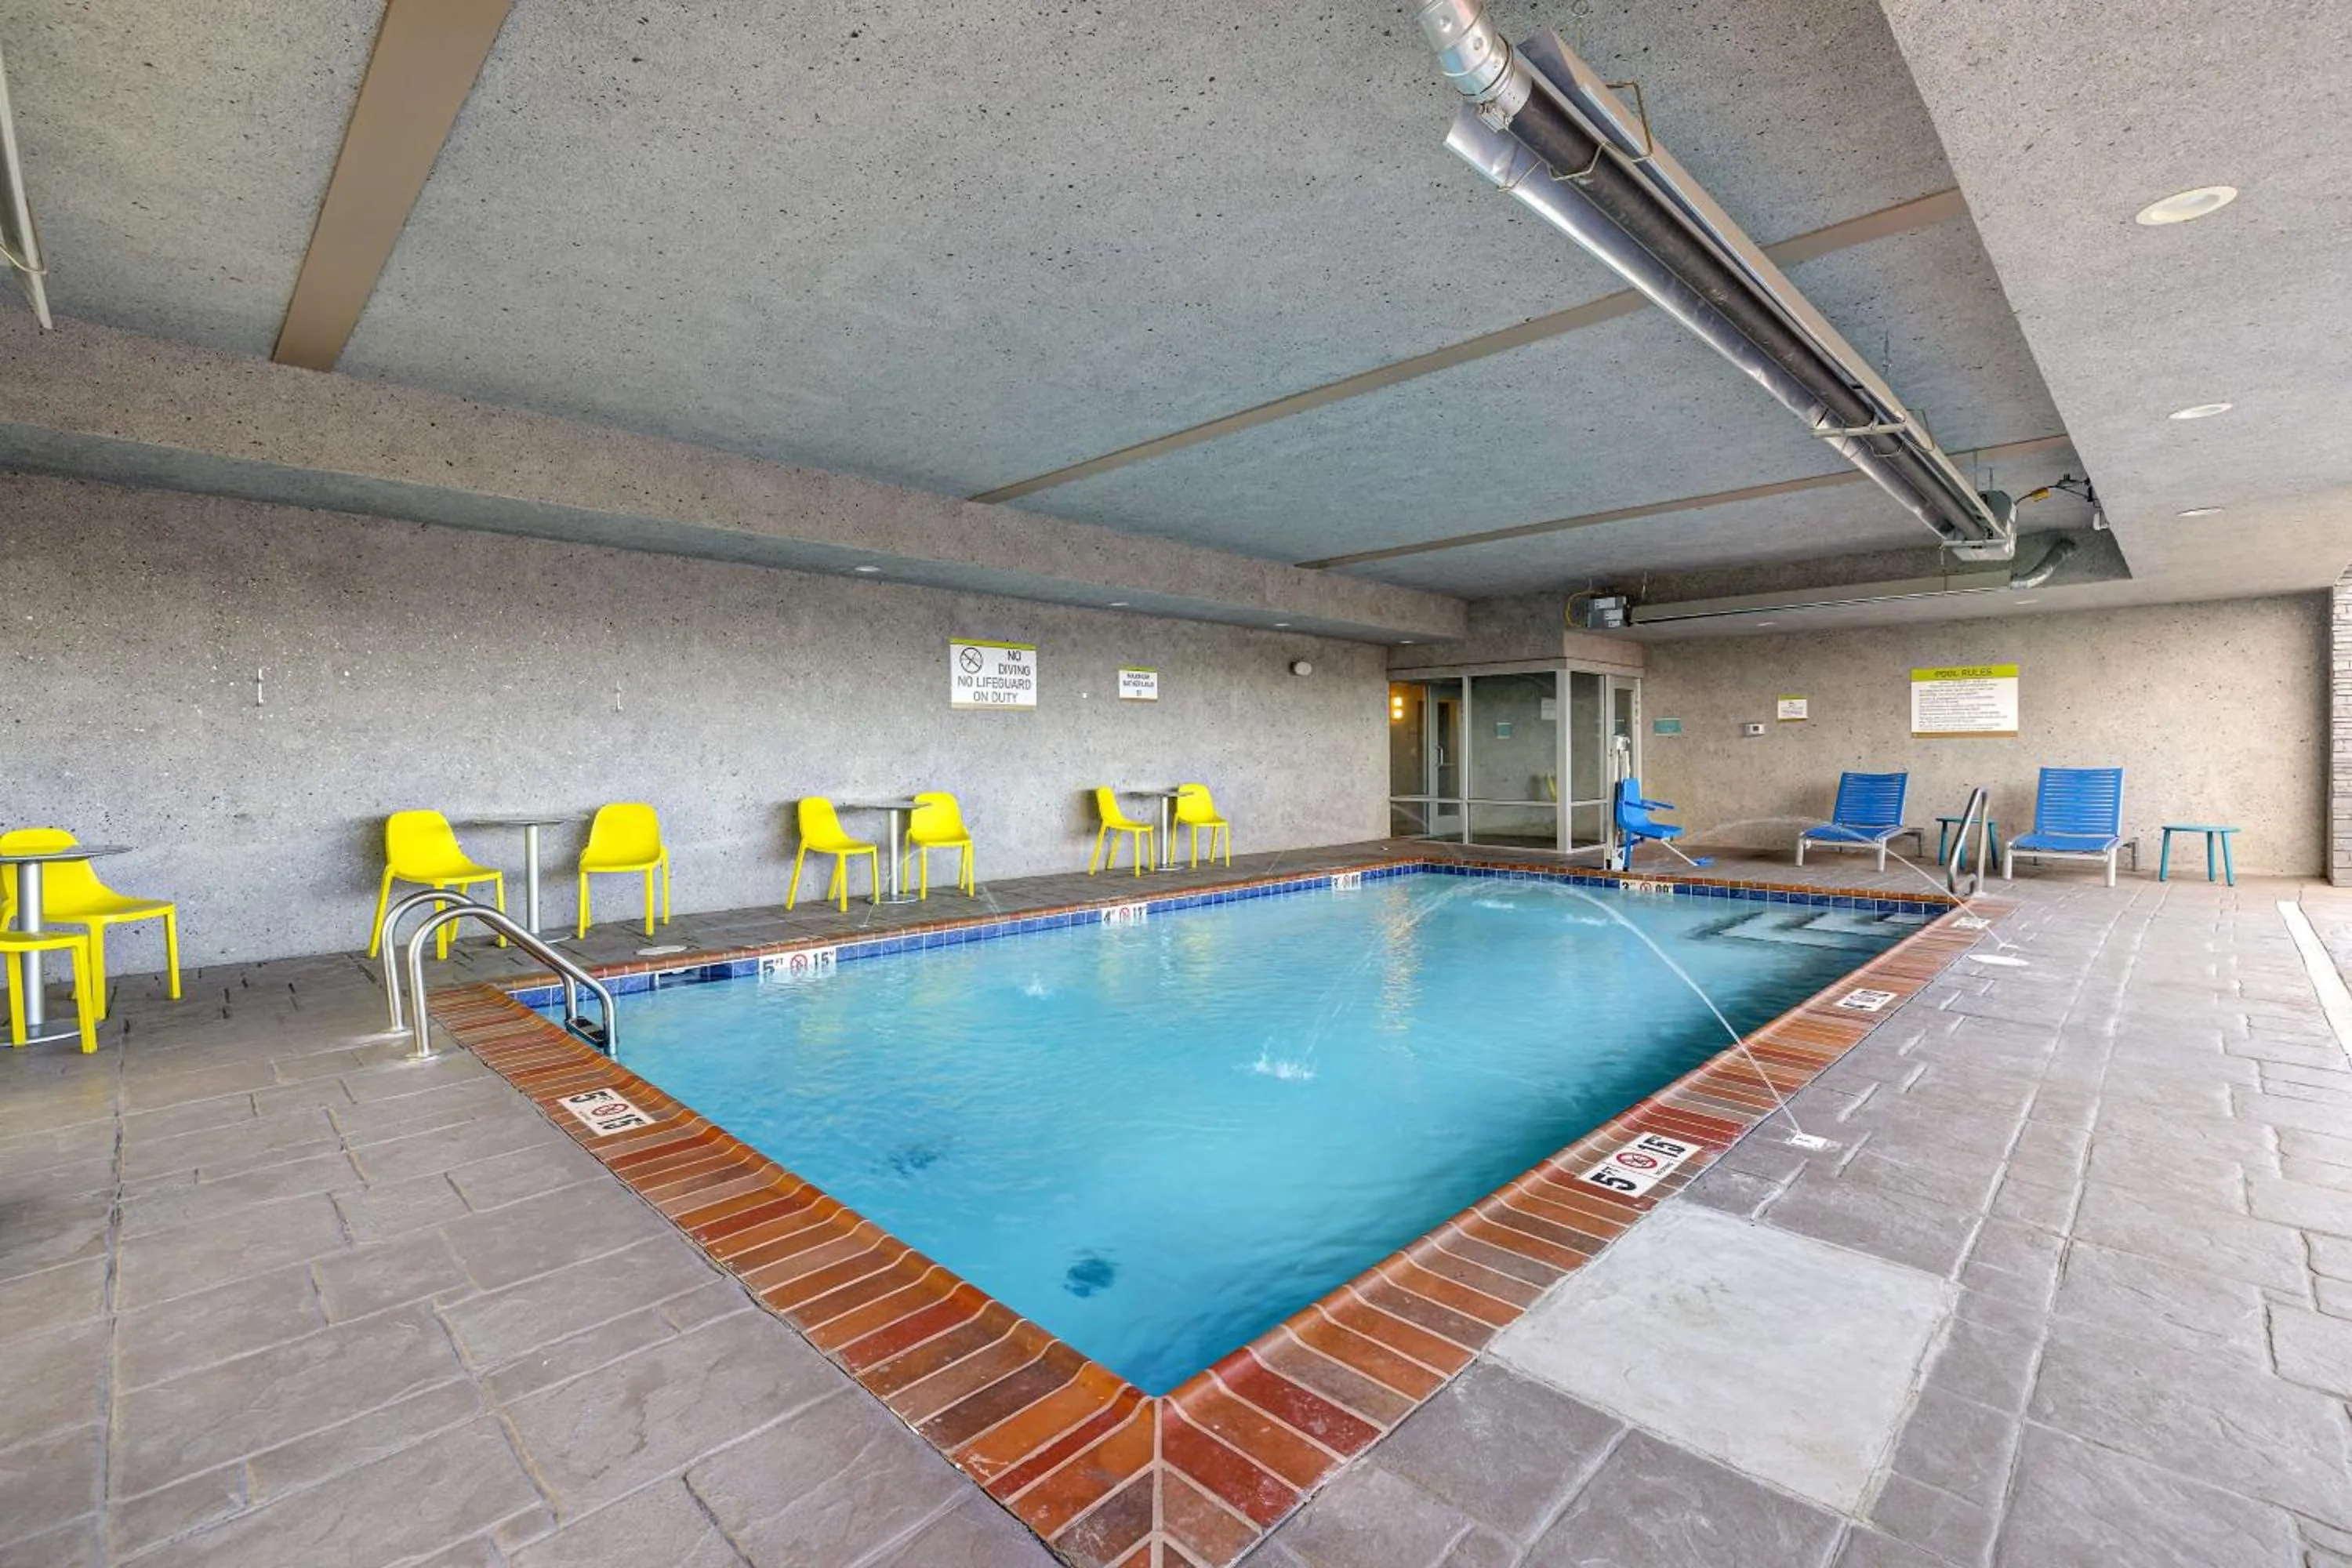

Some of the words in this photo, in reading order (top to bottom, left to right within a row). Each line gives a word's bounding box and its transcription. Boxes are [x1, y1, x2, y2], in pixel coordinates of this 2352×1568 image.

[1007, 650, 1022, 661] NO
[997, 663, 1031, 676] DIVING
[957, 675, 974, 688] NO
[976, 677, 1031, 691] LIFEGUARD
[973, 691, 989, 702] ON
[992, 691, 1018, 703] DUTY
[763, 959, 775, 973] 5
[1638, 1137, 1685, 1158] 15
[1590, 1172, 1637, 1190] 5
